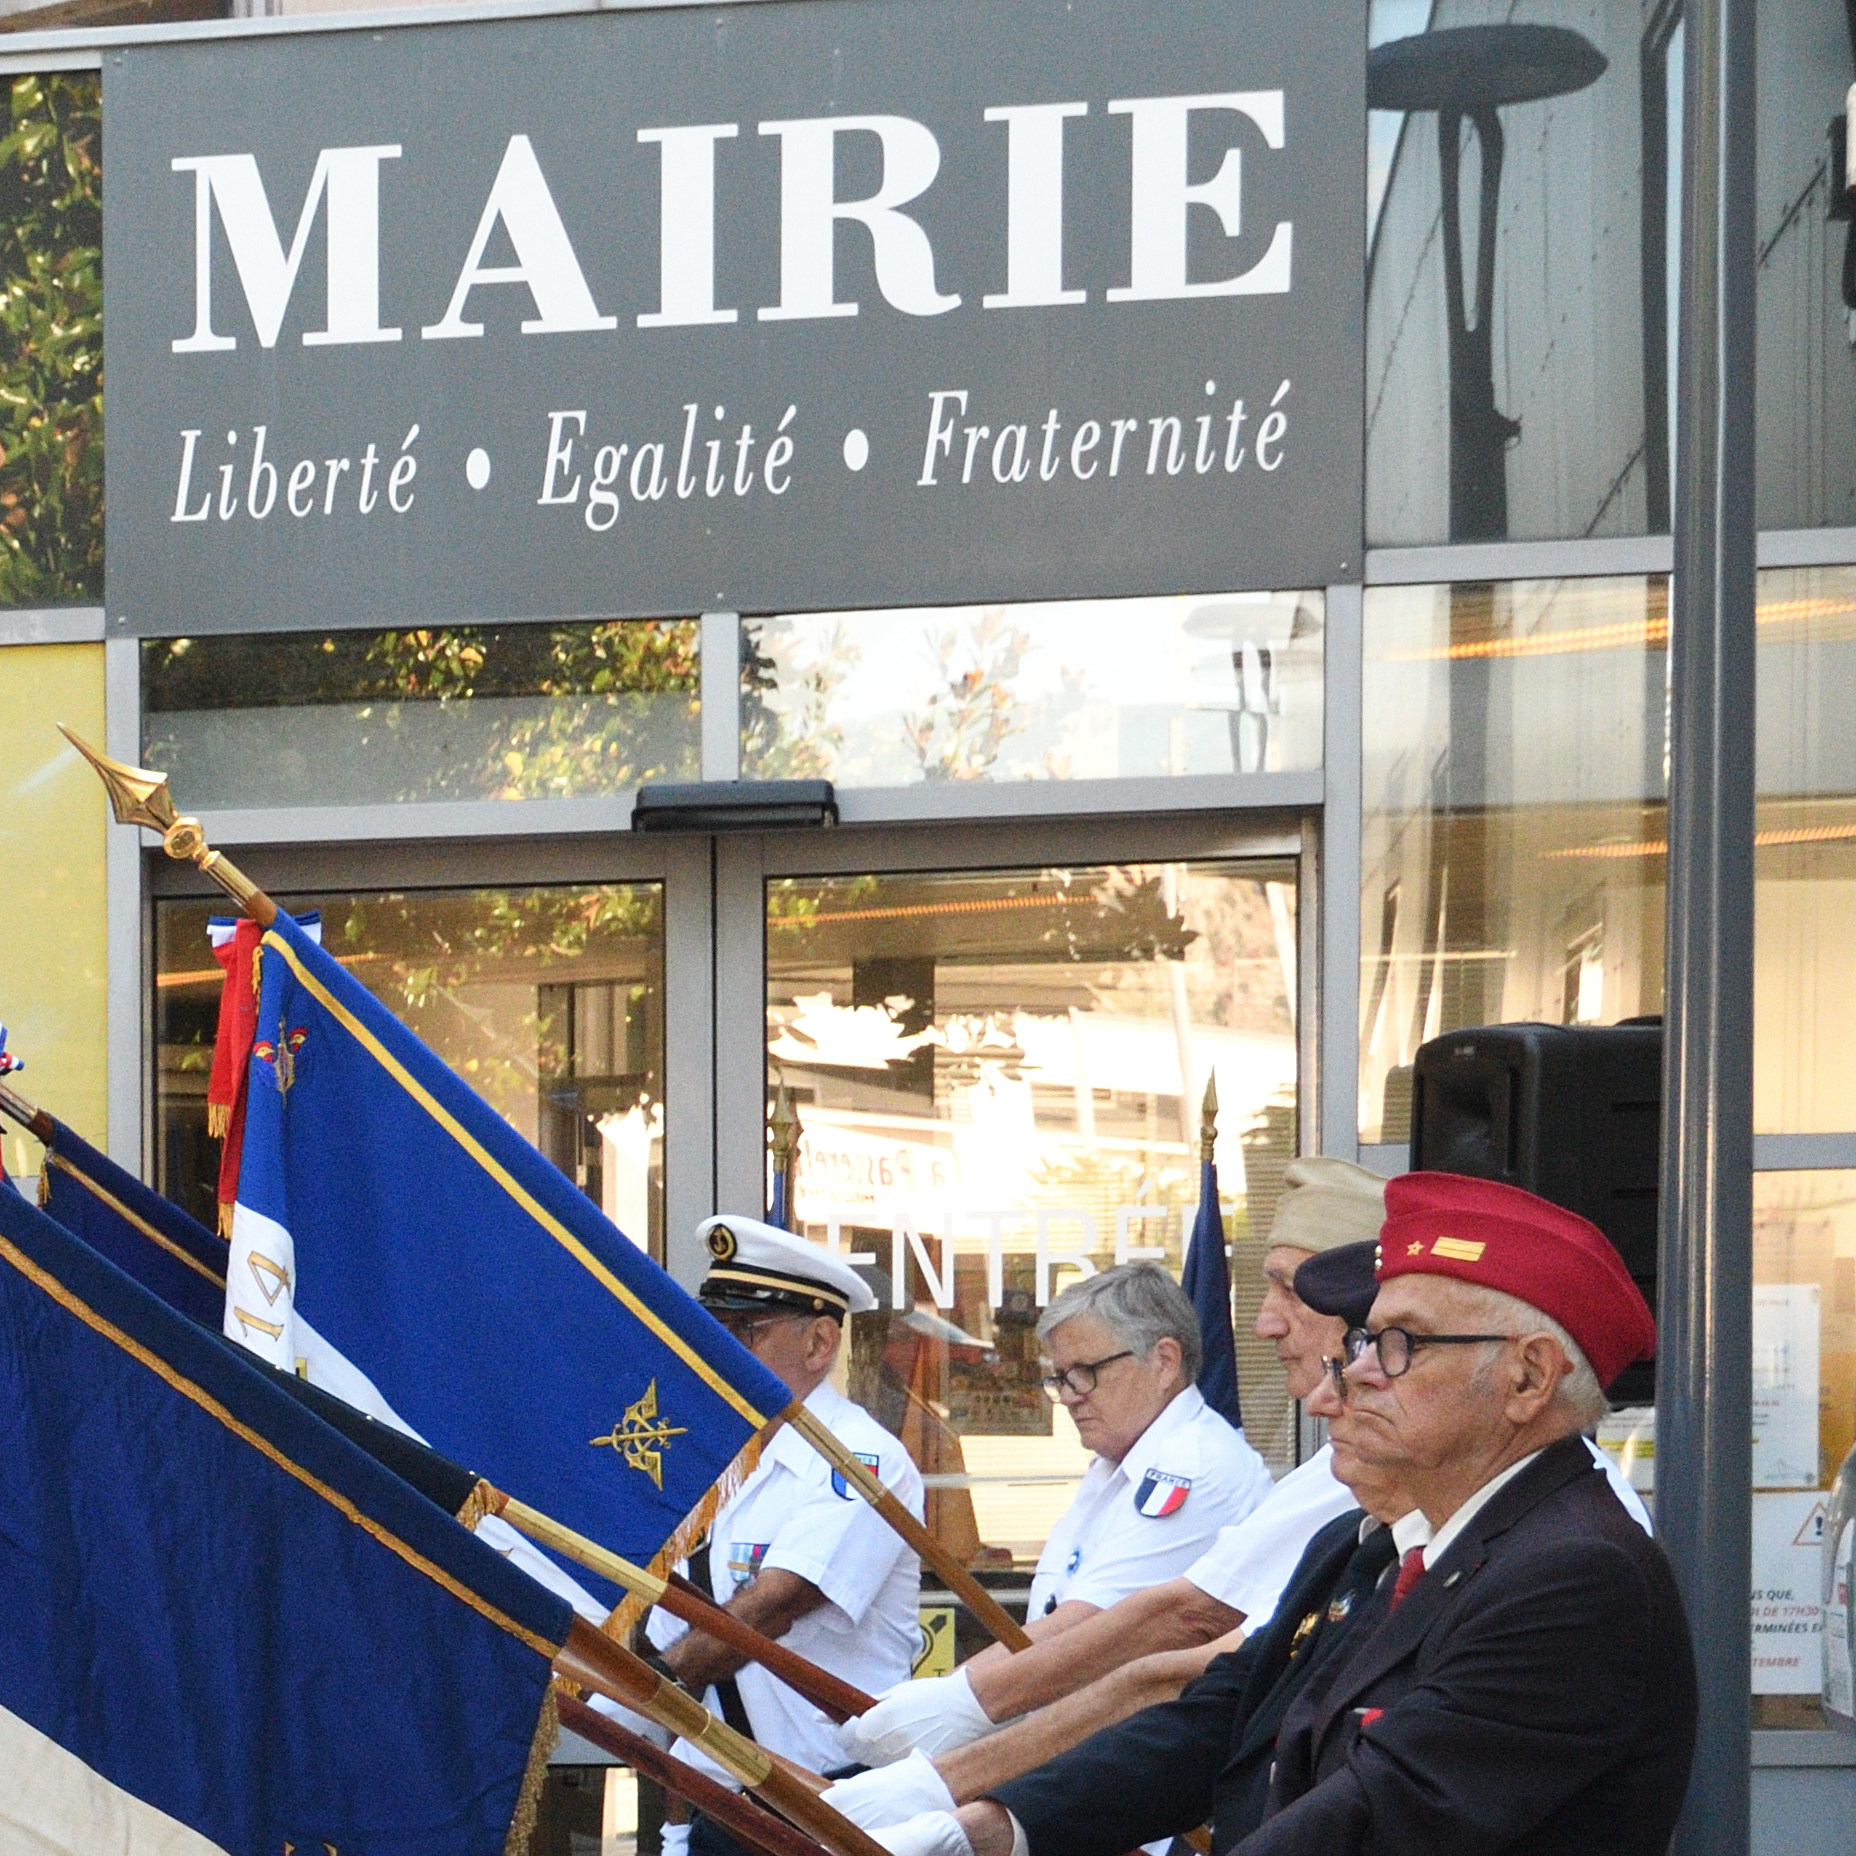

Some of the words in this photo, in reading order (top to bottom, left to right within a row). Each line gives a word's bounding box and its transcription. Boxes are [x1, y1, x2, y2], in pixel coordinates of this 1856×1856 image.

[171, 88, 1293, 354] MAIRIE
[171, 423, 420, 523] Liberté
[538, 403, 798, 533] Egalité
[918, 378, 1290, 488] Fraternité
